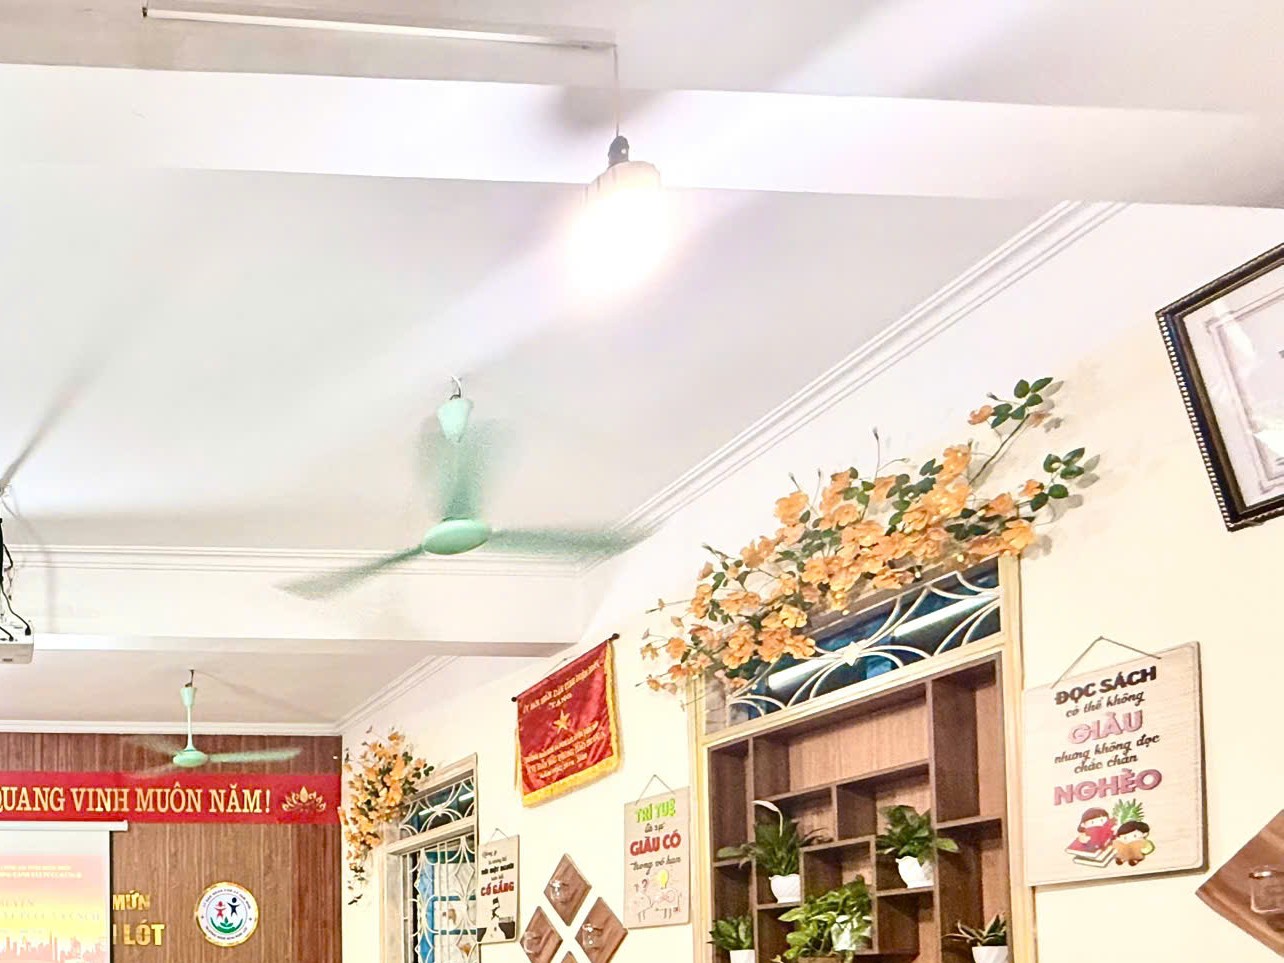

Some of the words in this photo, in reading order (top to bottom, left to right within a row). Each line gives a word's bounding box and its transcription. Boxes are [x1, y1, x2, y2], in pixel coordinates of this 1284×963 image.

[1054, 682, 1096, 705] ĐỌC
[1099, 665, 1156, 693] SÁCH
[1106, 691, 1145, 707] không
[1068, 709, 1143, 744] GIÀU
[1094, 741, 1132, 756] không
[1136, 734, 1160, 748] đọc
[70, 787, 129, 813] VINH
[135, 781, 202, 813] MUÔN
[209, 784, 270, 813] NĂM!
[1054, 768, 1162, 806] NGHÈO
[662, 829, 681, 849] CÓ
[112, 890, 151, 911] MỨN
[124, 919, 165, 946] LÓT
